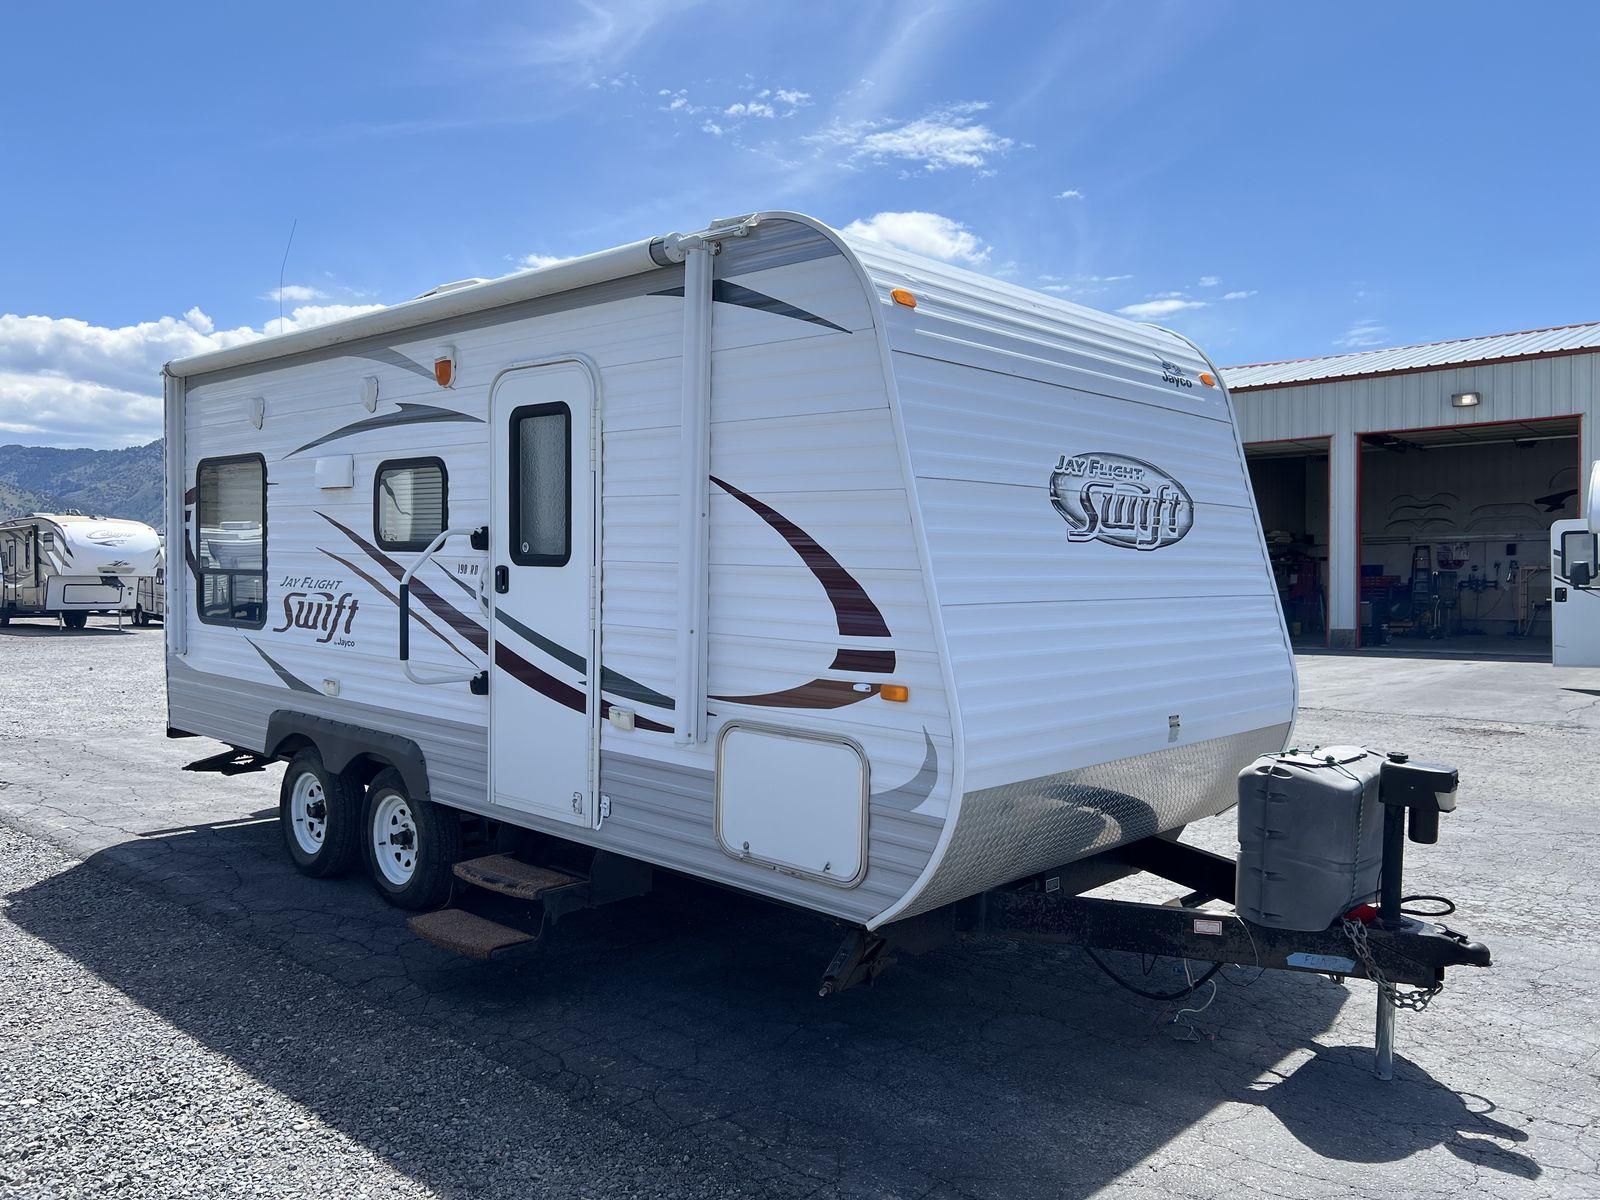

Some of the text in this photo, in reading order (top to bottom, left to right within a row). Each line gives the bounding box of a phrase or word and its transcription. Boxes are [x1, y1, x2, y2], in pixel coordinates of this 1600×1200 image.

[1162, 370, 1193, 388] Jayco
[1054, 454, 1144, 480] JAY FLIGHT
[1067, 481, 1182, 551] Swift
[280, 575, 344, 590] JAY FLIGHT
[272, 592, 360, 644] Swift
[337, 636, 356, 648] Jayco
